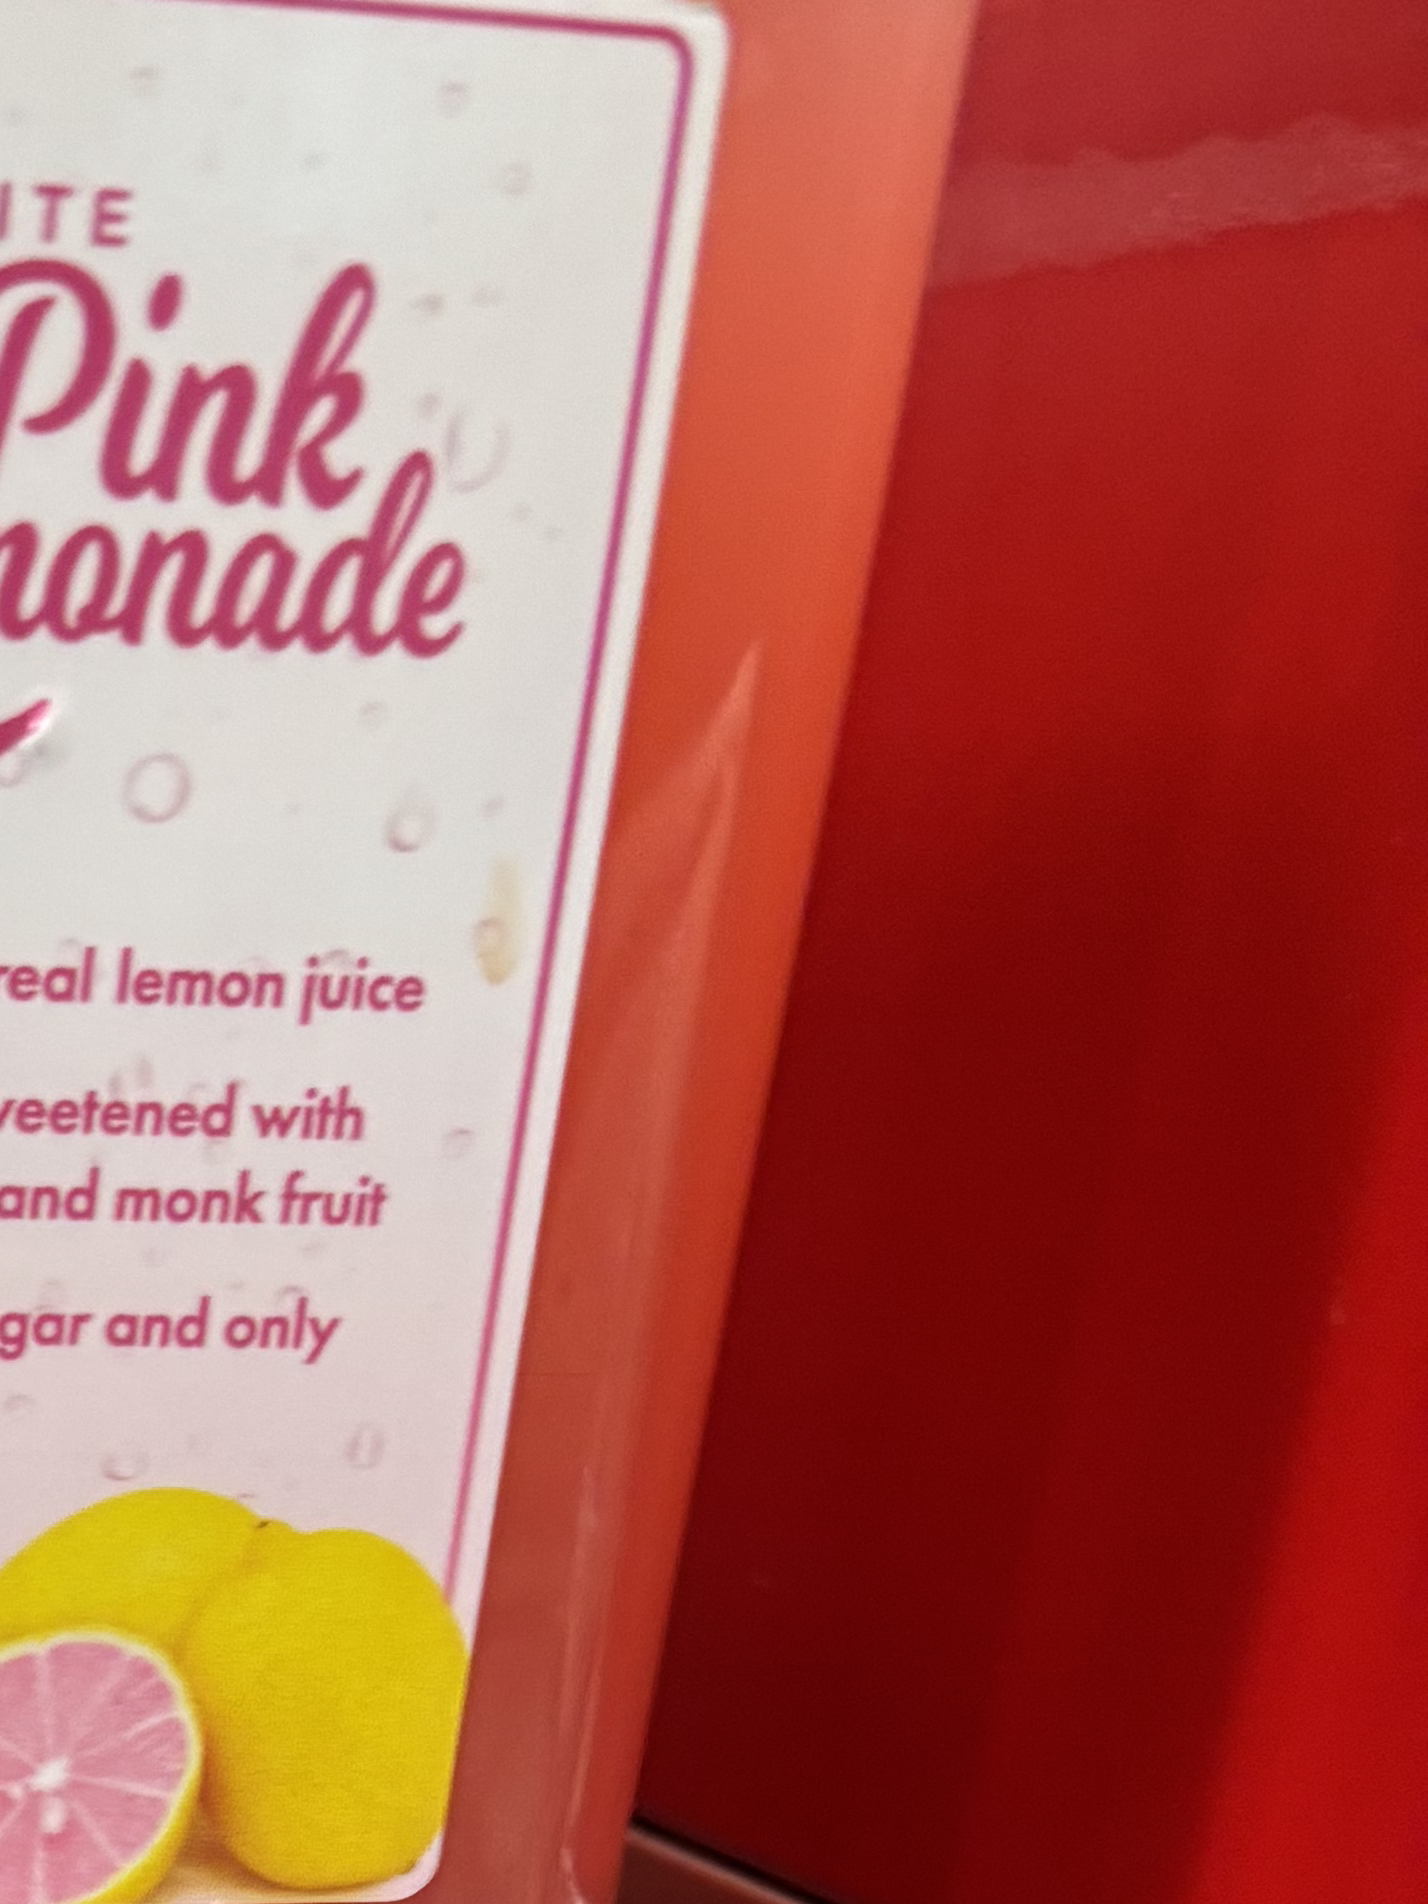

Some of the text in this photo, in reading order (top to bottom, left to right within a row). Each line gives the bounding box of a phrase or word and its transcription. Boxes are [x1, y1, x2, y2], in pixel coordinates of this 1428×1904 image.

[115, 947, 286, 1010] lemon
[299, 957, 426, 1025] juice
[251, 1087, 364, 1141] with
[113, 1171, 263, 1226] monk
[279, 1171, 387, 1228] fruit
[105, 1295, 211, 1350] and
[223, 1297, 340, 1365] only
